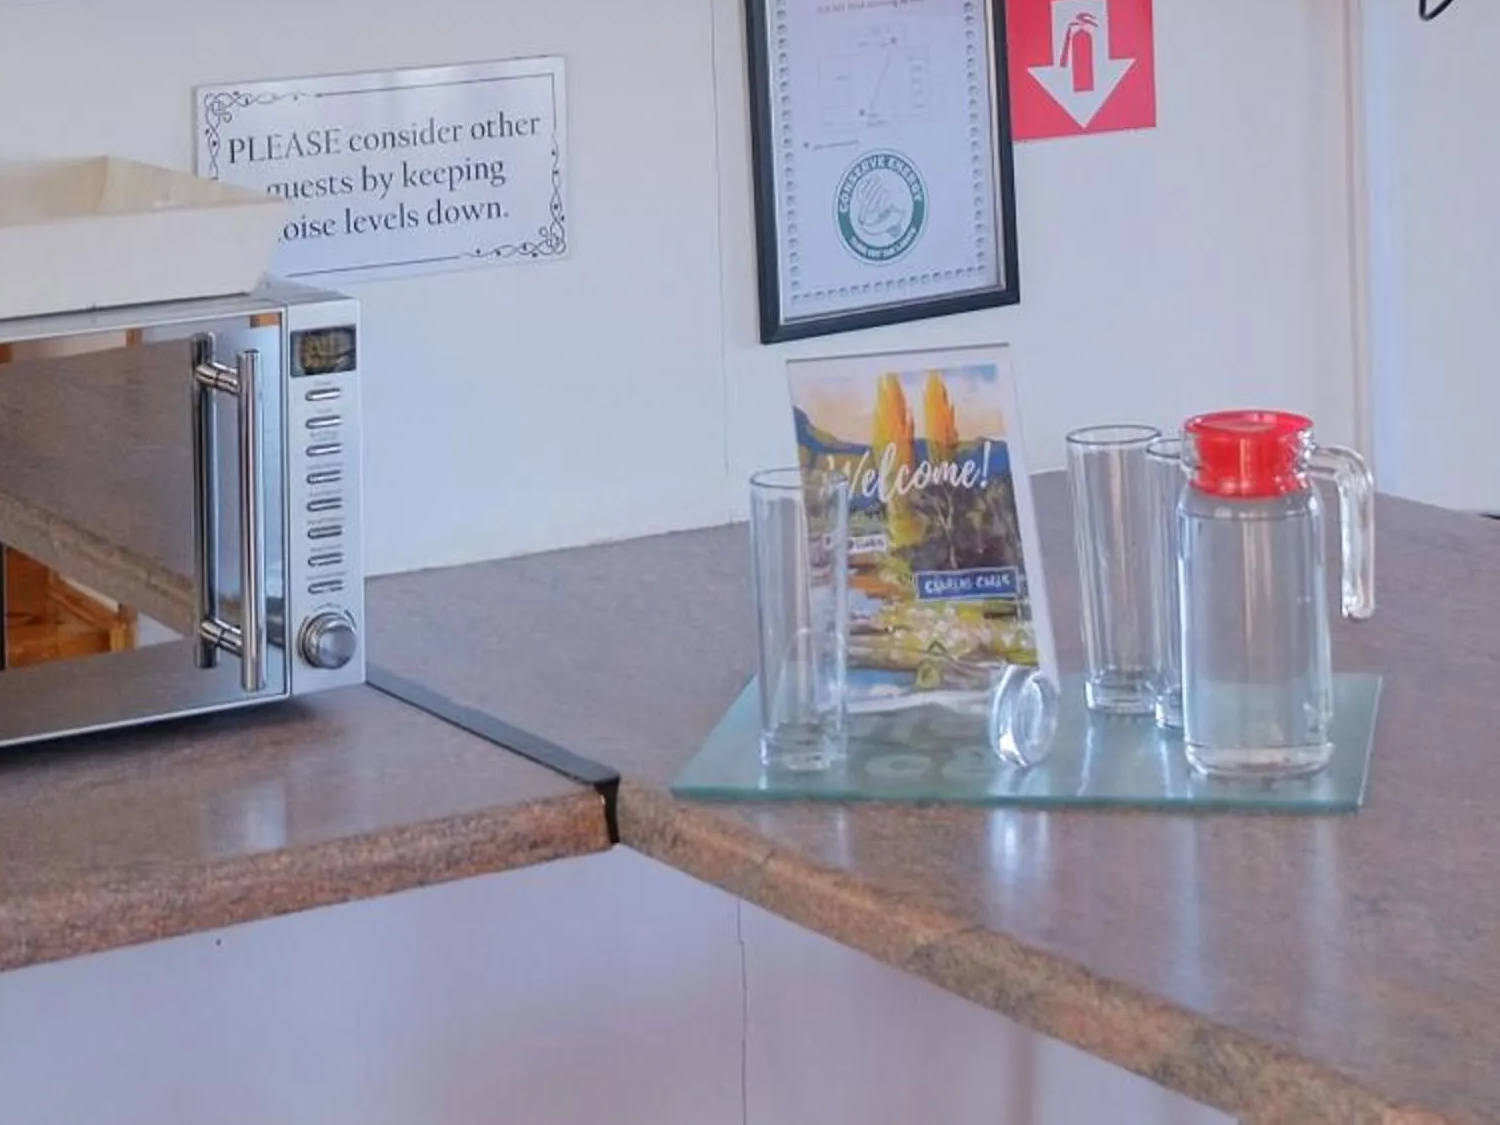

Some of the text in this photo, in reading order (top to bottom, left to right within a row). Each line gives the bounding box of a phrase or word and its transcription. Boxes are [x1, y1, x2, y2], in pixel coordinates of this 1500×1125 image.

[228, 110, 541, 164] PLEASE consider other
[361, 164, 395, 201] by
[402, 157, 506, 194] keeping
[278, 199, 510, 243] oise levels down.
